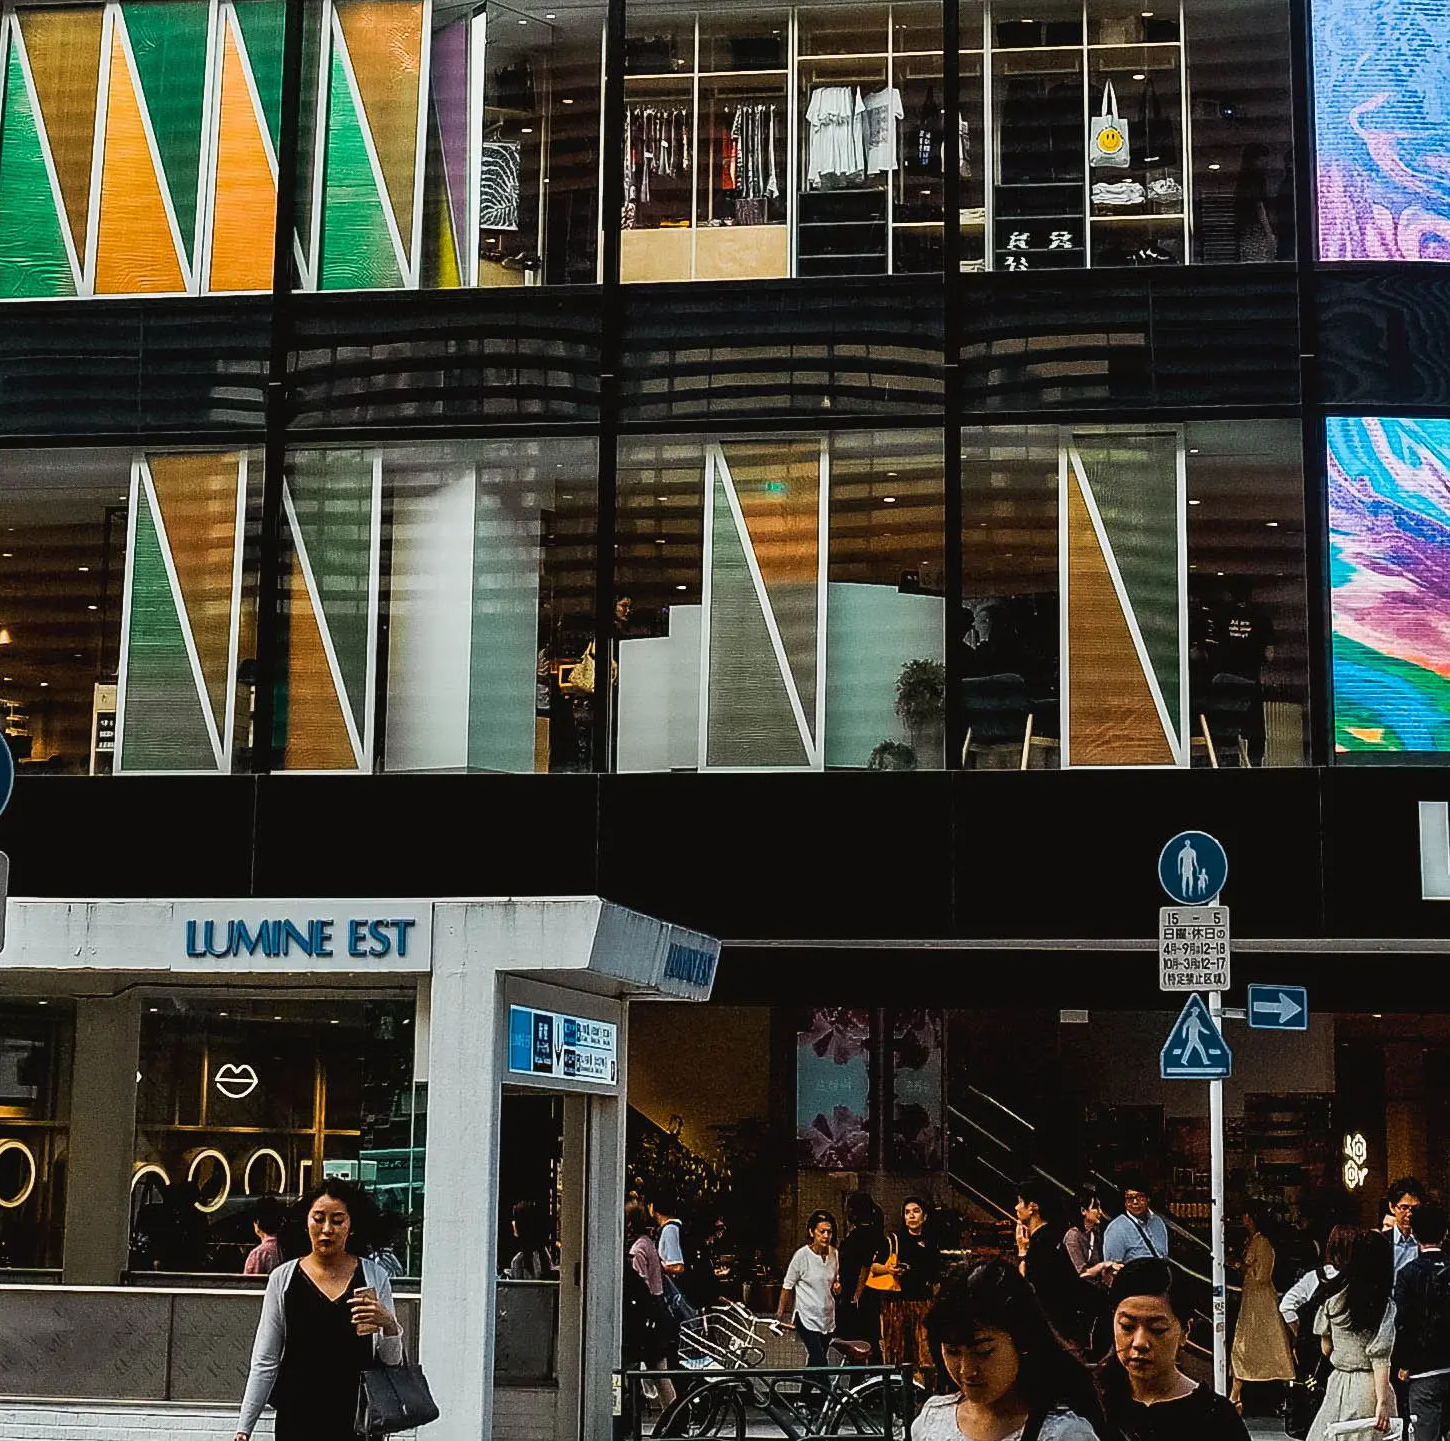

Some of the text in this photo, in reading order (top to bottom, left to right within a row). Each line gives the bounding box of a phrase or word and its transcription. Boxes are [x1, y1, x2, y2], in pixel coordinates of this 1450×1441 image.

[1166, 912, 1179, 925] 15
[1213, 912, 1222, 925] 5
[185, 918, 416, 959] LUMINE EST
